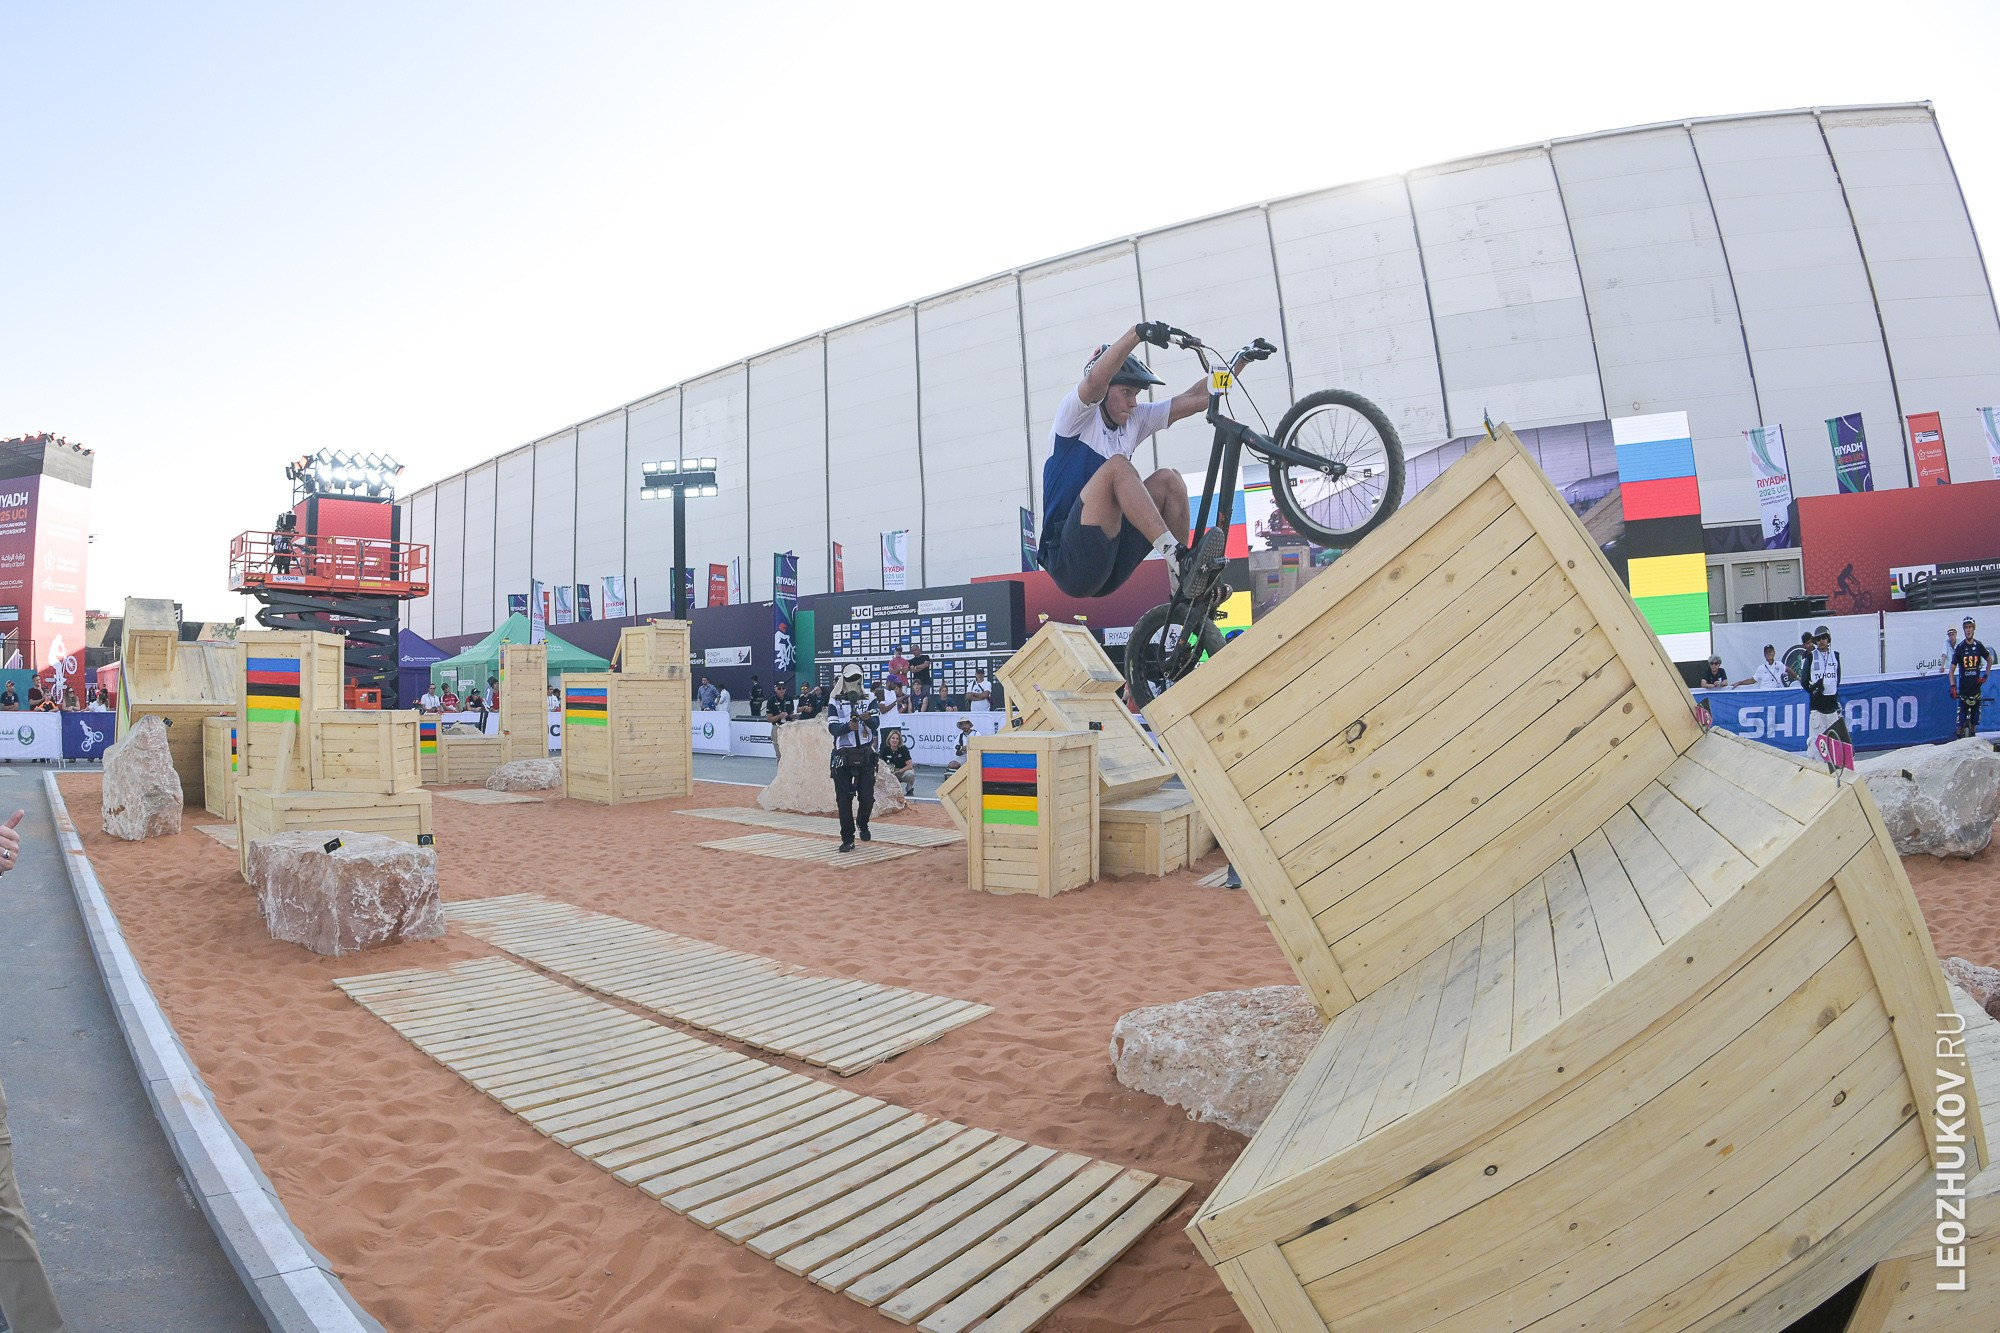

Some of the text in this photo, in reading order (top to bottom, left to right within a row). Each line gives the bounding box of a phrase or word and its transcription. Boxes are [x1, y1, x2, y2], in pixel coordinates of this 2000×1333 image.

[1220, 374, 1228, 387] 12
[1834, 441, 1864, 456] RIYADH
[1757, 474, 1787, 489] RIYADH
[1759, 485, 1788, 498] 2025 UCI
[1761, 497, 1789, 506] CHAMPIONSHIPS
[12, 508, 28, 520] UCI
[776, 577, 797, 586] RIYADH
[1898, 570, 1933, 593] UC
[855, 607, 871, 617] UCI
[1108, 631, 1131, 640] RIYAD
[1916, 659, 1937, 670] الرياض
[1738, 695, 1918, 739] SHIANO
[919, 734, 945, 742] SAUDI
